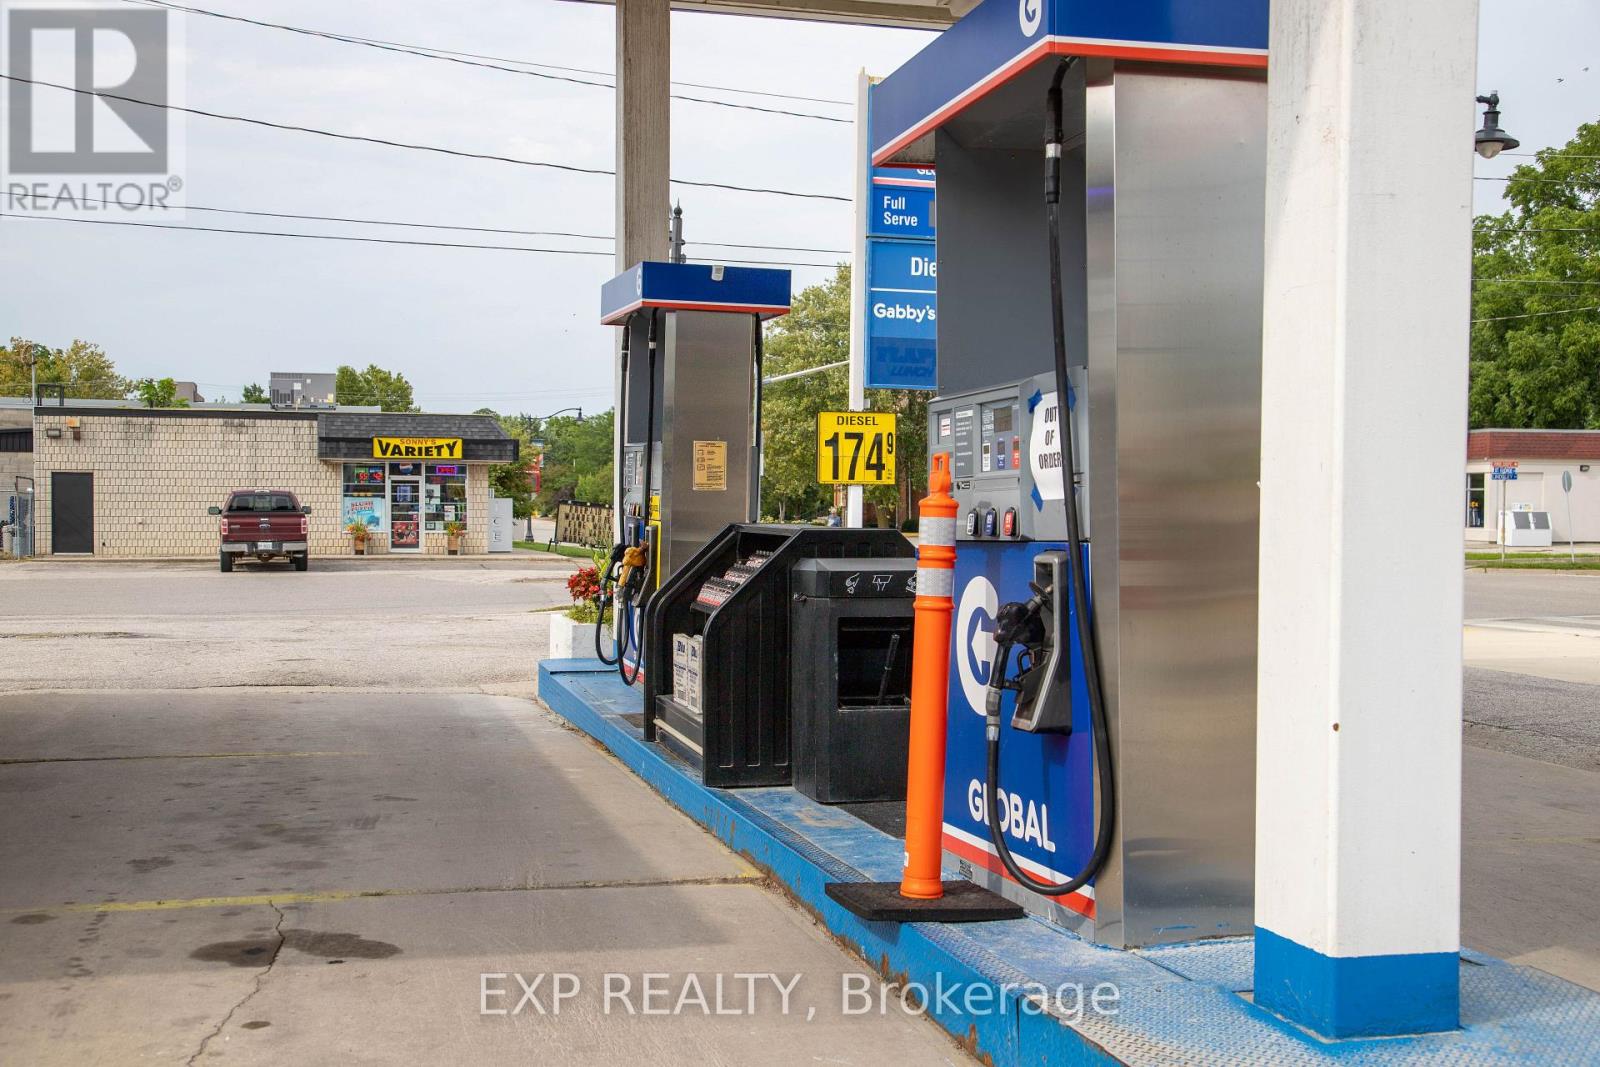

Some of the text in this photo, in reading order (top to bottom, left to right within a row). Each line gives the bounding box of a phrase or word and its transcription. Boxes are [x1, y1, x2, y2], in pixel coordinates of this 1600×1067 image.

[883, 196, 905, 209] Full
[883, 212, 918, 226] Serve
[873, 303, 936, 323] Gabby's
[836, 415, 878, 426] DIESEL
[1044, 407, 1058, 423] OUT
[1044, 430, 1055, 446] OF
[377, 439, 459, 457] VARIETY
[825, 432, 894, 480] 174 9
[1038, 451, 1062, 469] ORDER
